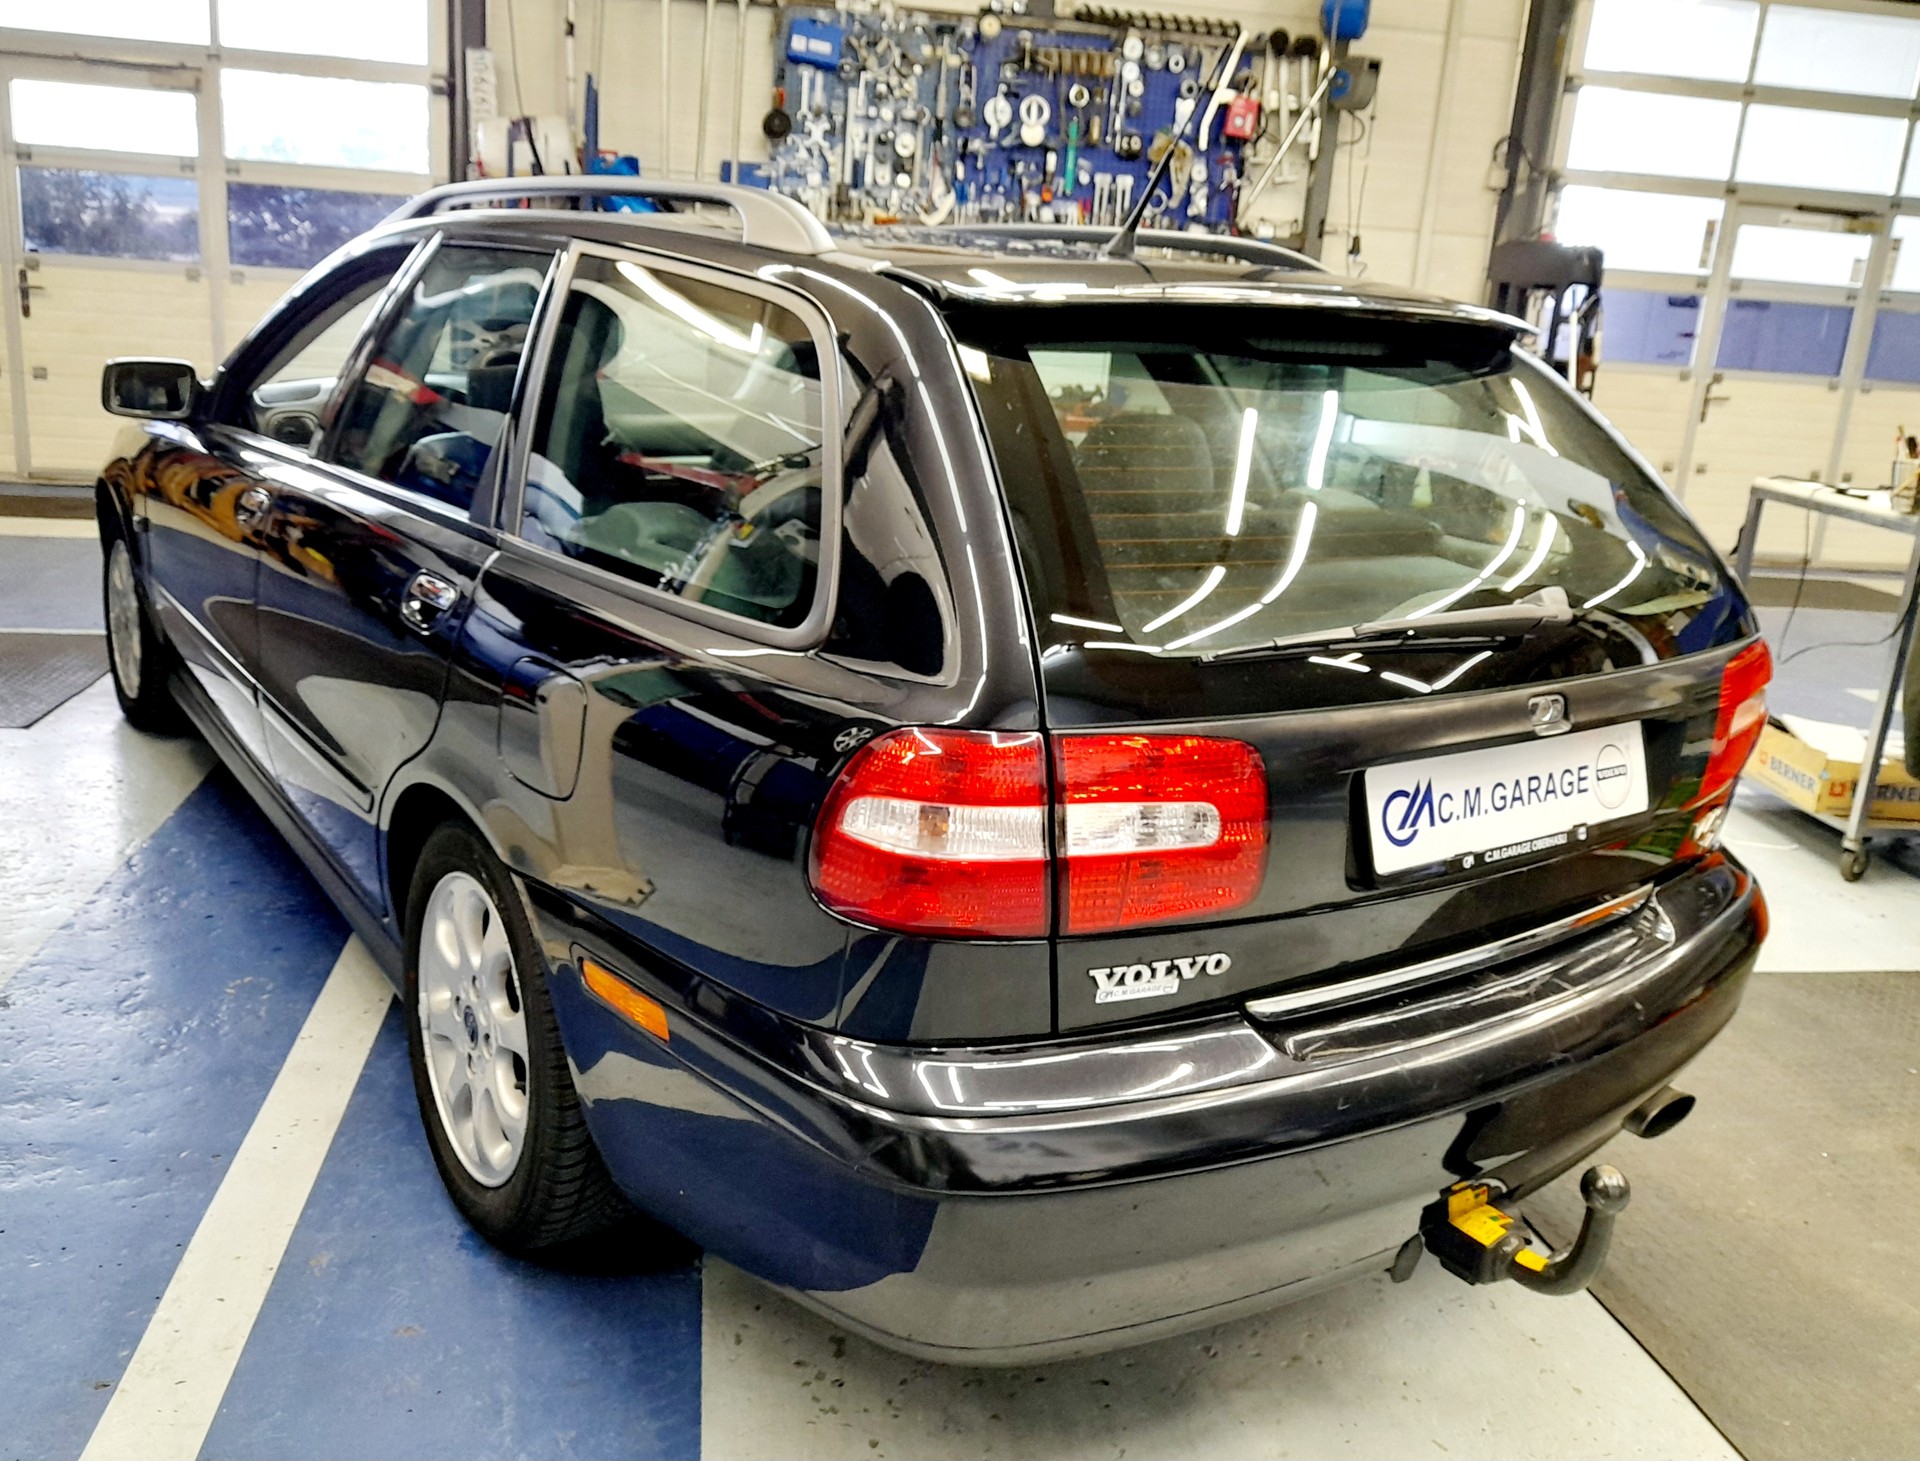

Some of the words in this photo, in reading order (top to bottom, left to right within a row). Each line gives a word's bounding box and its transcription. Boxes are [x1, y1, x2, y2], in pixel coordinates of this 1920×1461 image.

[1770, 755, 1816, 793] BERNER
[1438, 765, 1590, 824] C.M.GARAGE
[1088, 953, 1232, 990] VOLVO
